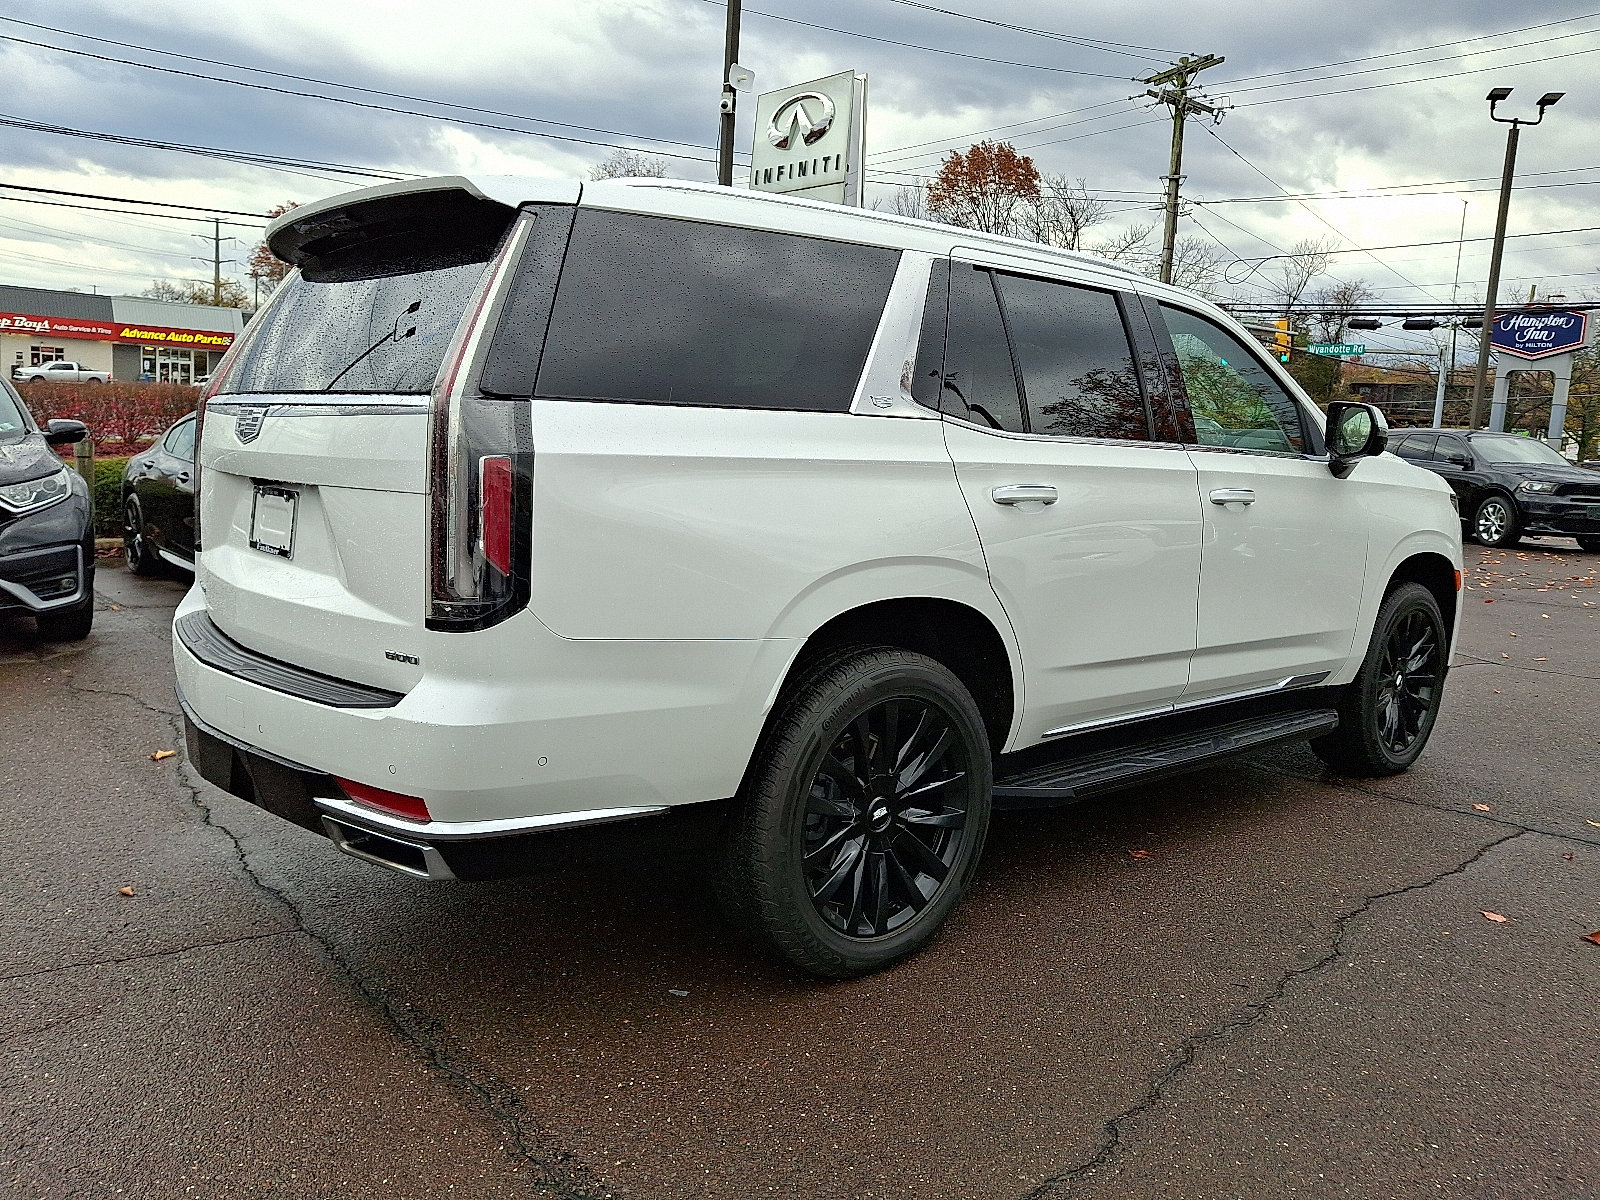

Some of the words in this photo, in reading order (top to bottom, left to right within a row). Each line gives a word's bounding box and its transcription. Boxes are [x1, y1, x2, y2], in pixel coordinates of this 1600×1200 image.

[754, 154, 842, 185] INFINITI
[13, 317, 50, 332] Boys
[69, 325, 91, 333] Service
[1500, 314, 1575, 331] Hampton
[120, 328, 166, 341] Advance
[166, 331, 193, 343] Auto
[194, 334, 223, 345] Parts
[1516, 327, 1555, 341] Inn
[1309, 344, 1350, 354] Wyandotte
[1353, 345, 1363, 354] Rd
[384, 649, 420, 666] 600
[821, 683, 866, 732] Continental
